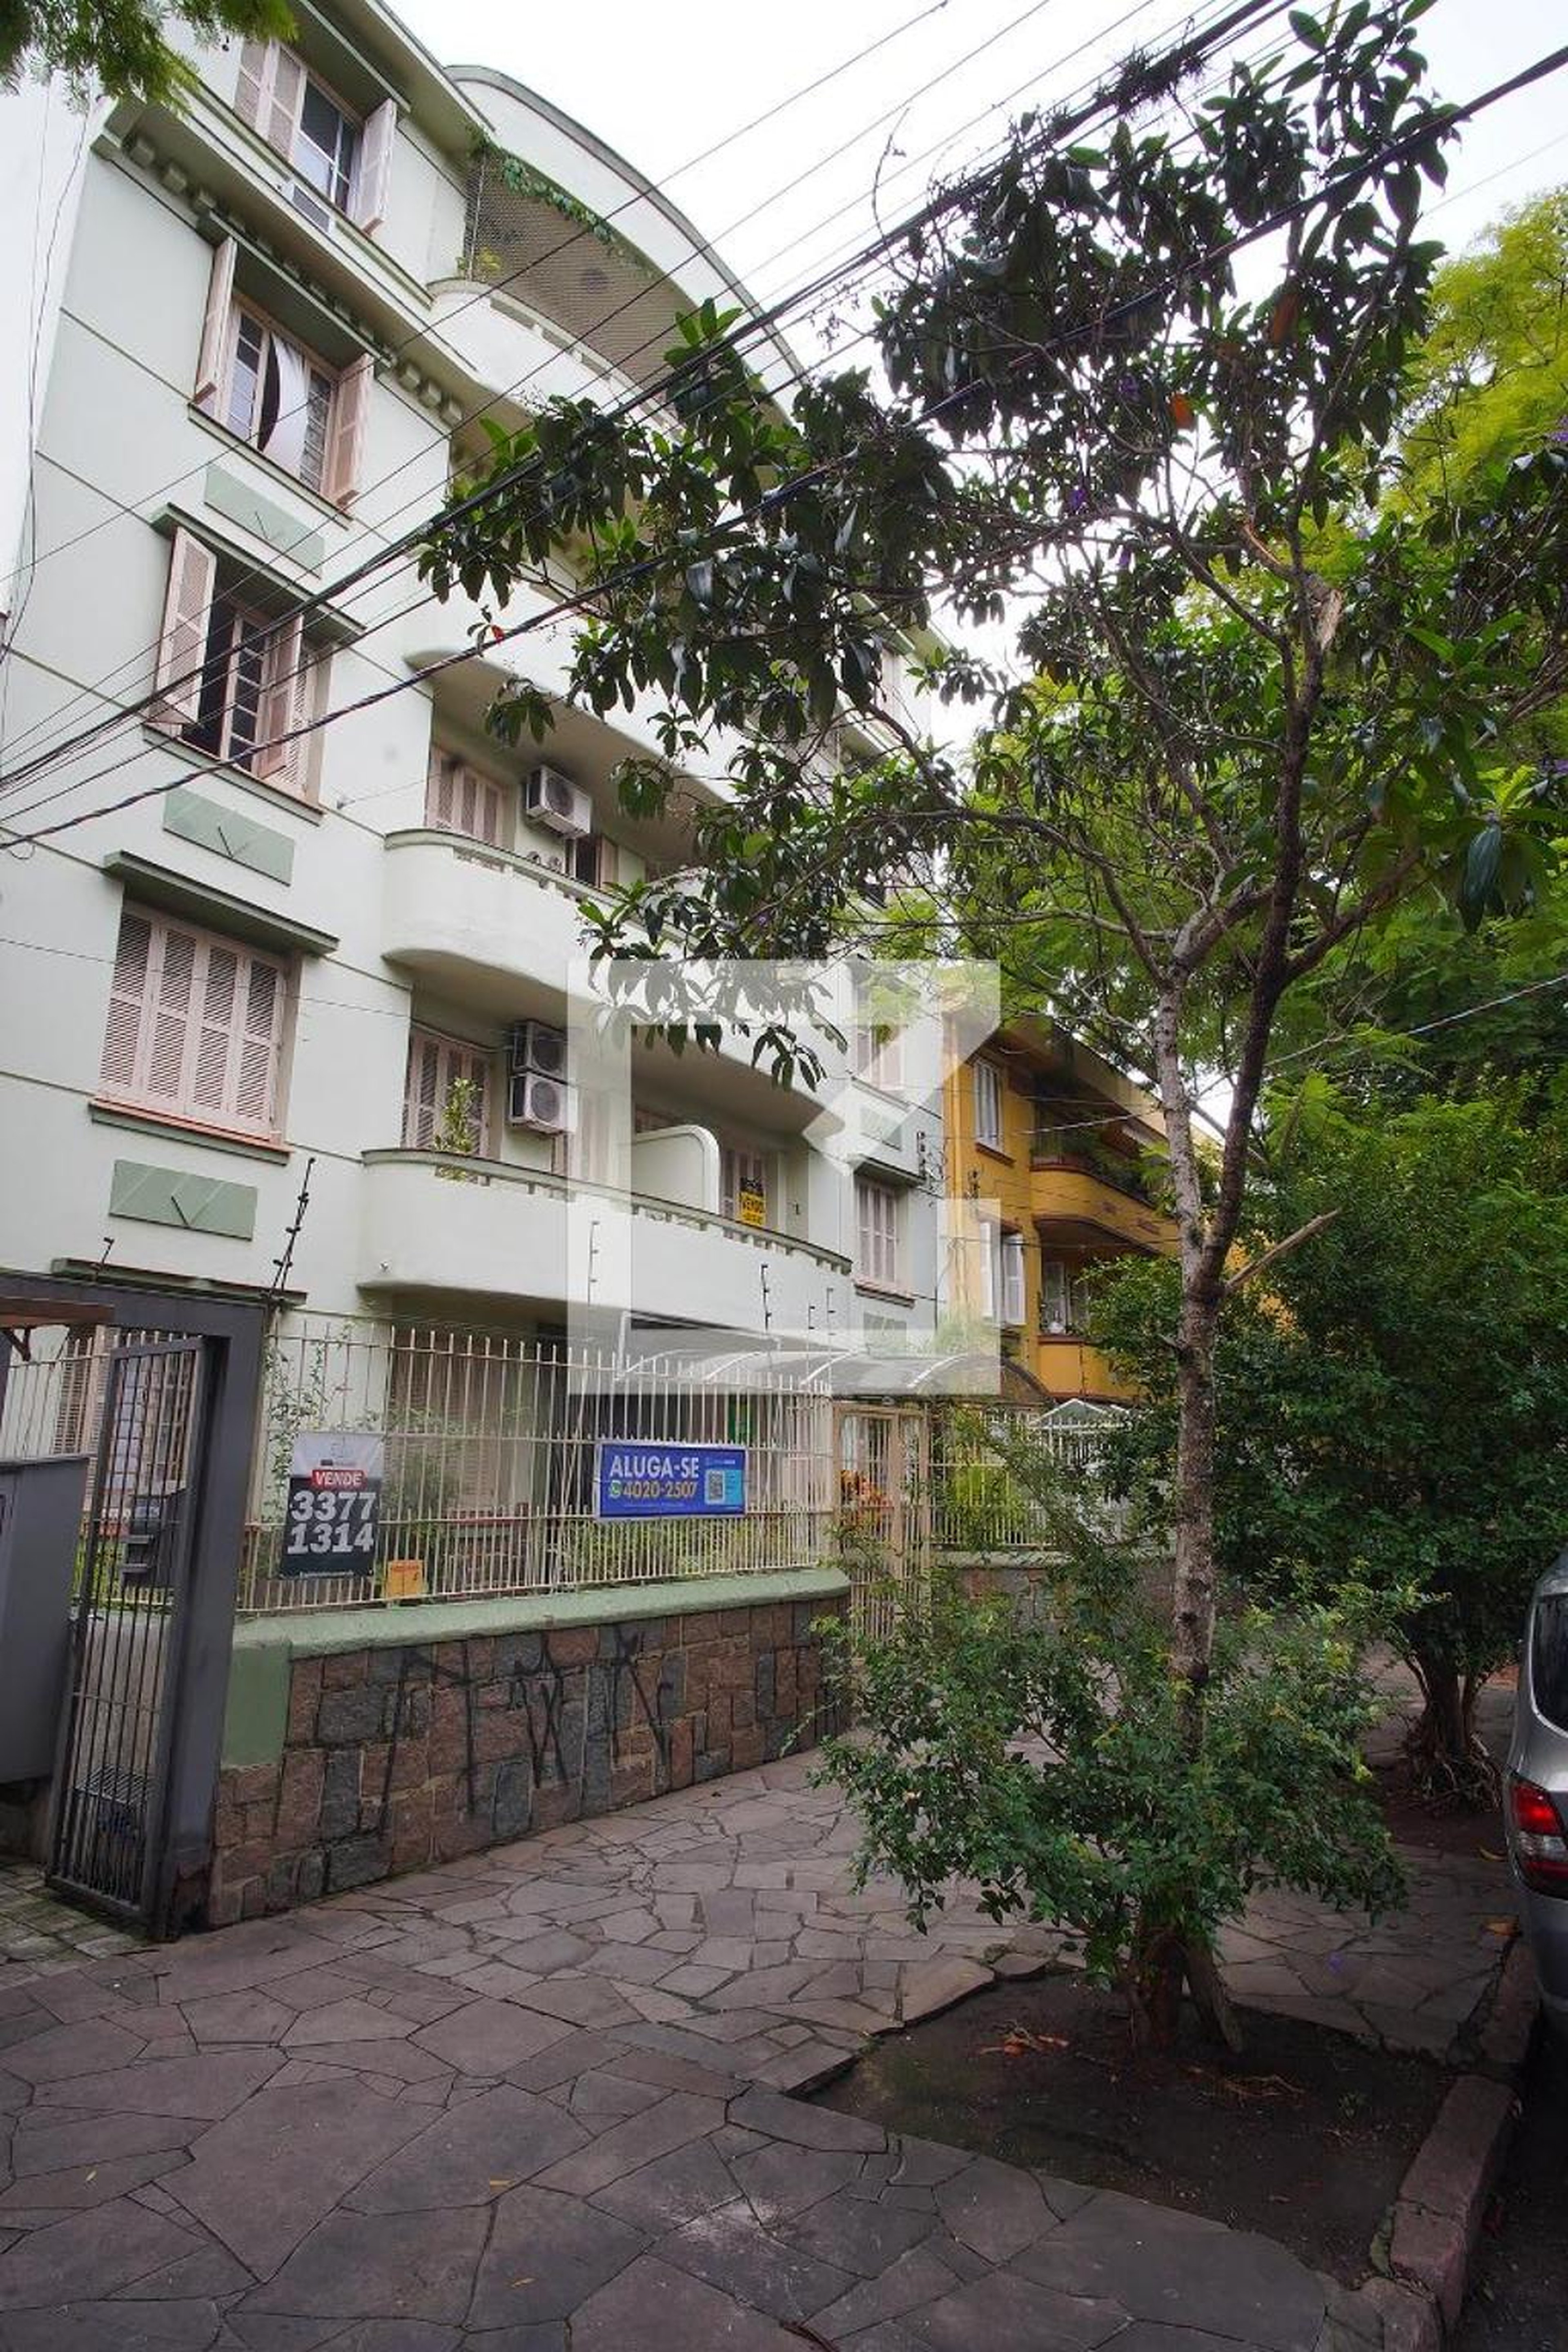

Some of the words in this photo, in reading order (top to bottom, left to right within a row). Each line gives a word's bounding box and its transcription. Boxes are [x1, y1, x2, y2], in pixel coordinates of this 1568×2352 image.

[610, 1455, 699, 1478] ALUGA-SE
[316, 1471, 362, 1486] VENDE
[624, 1480, 697, 1498] 4020-2507
[291, 1490, 376, 1521] 3377
[287, 1523, 374, 1554] 1314
